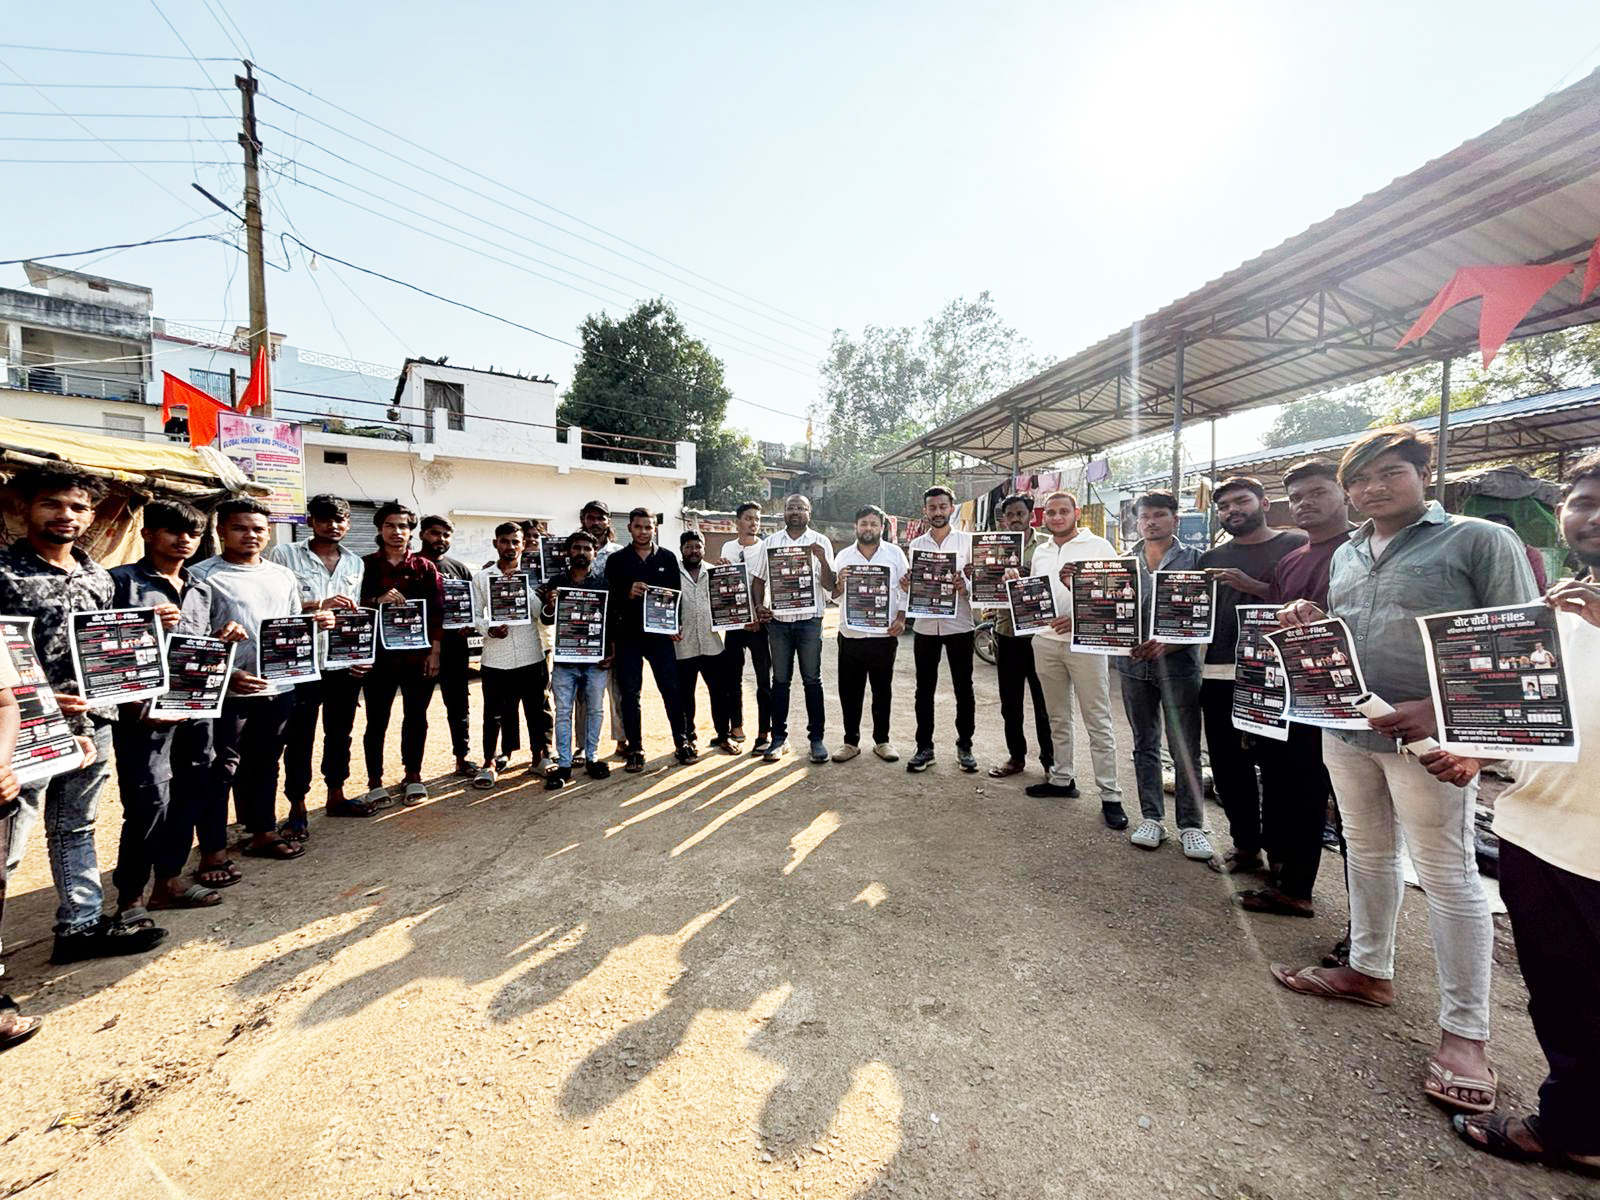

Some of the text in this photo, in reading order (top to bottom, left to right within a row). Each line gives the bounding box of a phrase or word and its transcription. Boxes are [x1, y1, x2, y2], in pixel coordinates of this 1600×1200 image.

[223, 438, 240, 448] GLOBAL
[272, 439, 288, 448] SPEECH
[1453, 612, 1525, 627] वोट चोरी H-Files
